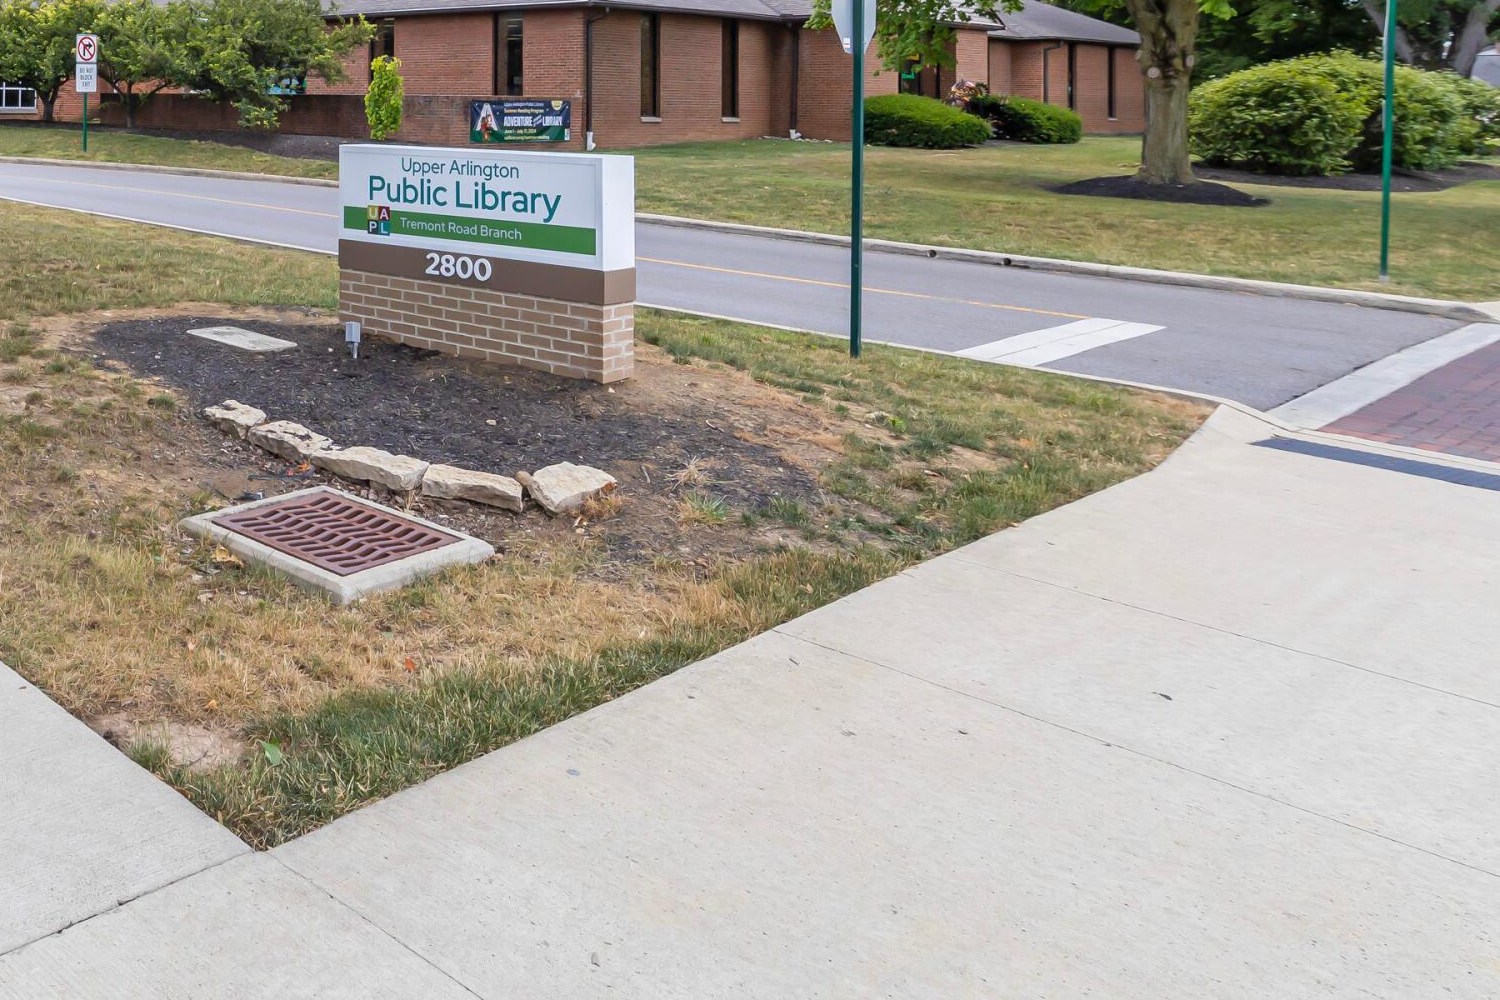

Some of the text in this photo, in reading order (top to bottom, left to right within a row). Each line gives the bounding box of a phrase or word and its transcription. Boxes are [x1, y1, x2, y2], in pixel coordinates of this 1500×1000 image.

[503, 116, 533, 127] ADVENTURE
[542, 116, 563, 126] LIBRARY
[401, 157, 520, 181] Upper Arlington
[369, 175, 562, 223] Public Library
[400, 217, 522, 240] Tremont Road Branch
[425, 252, 492, 281] 2800
